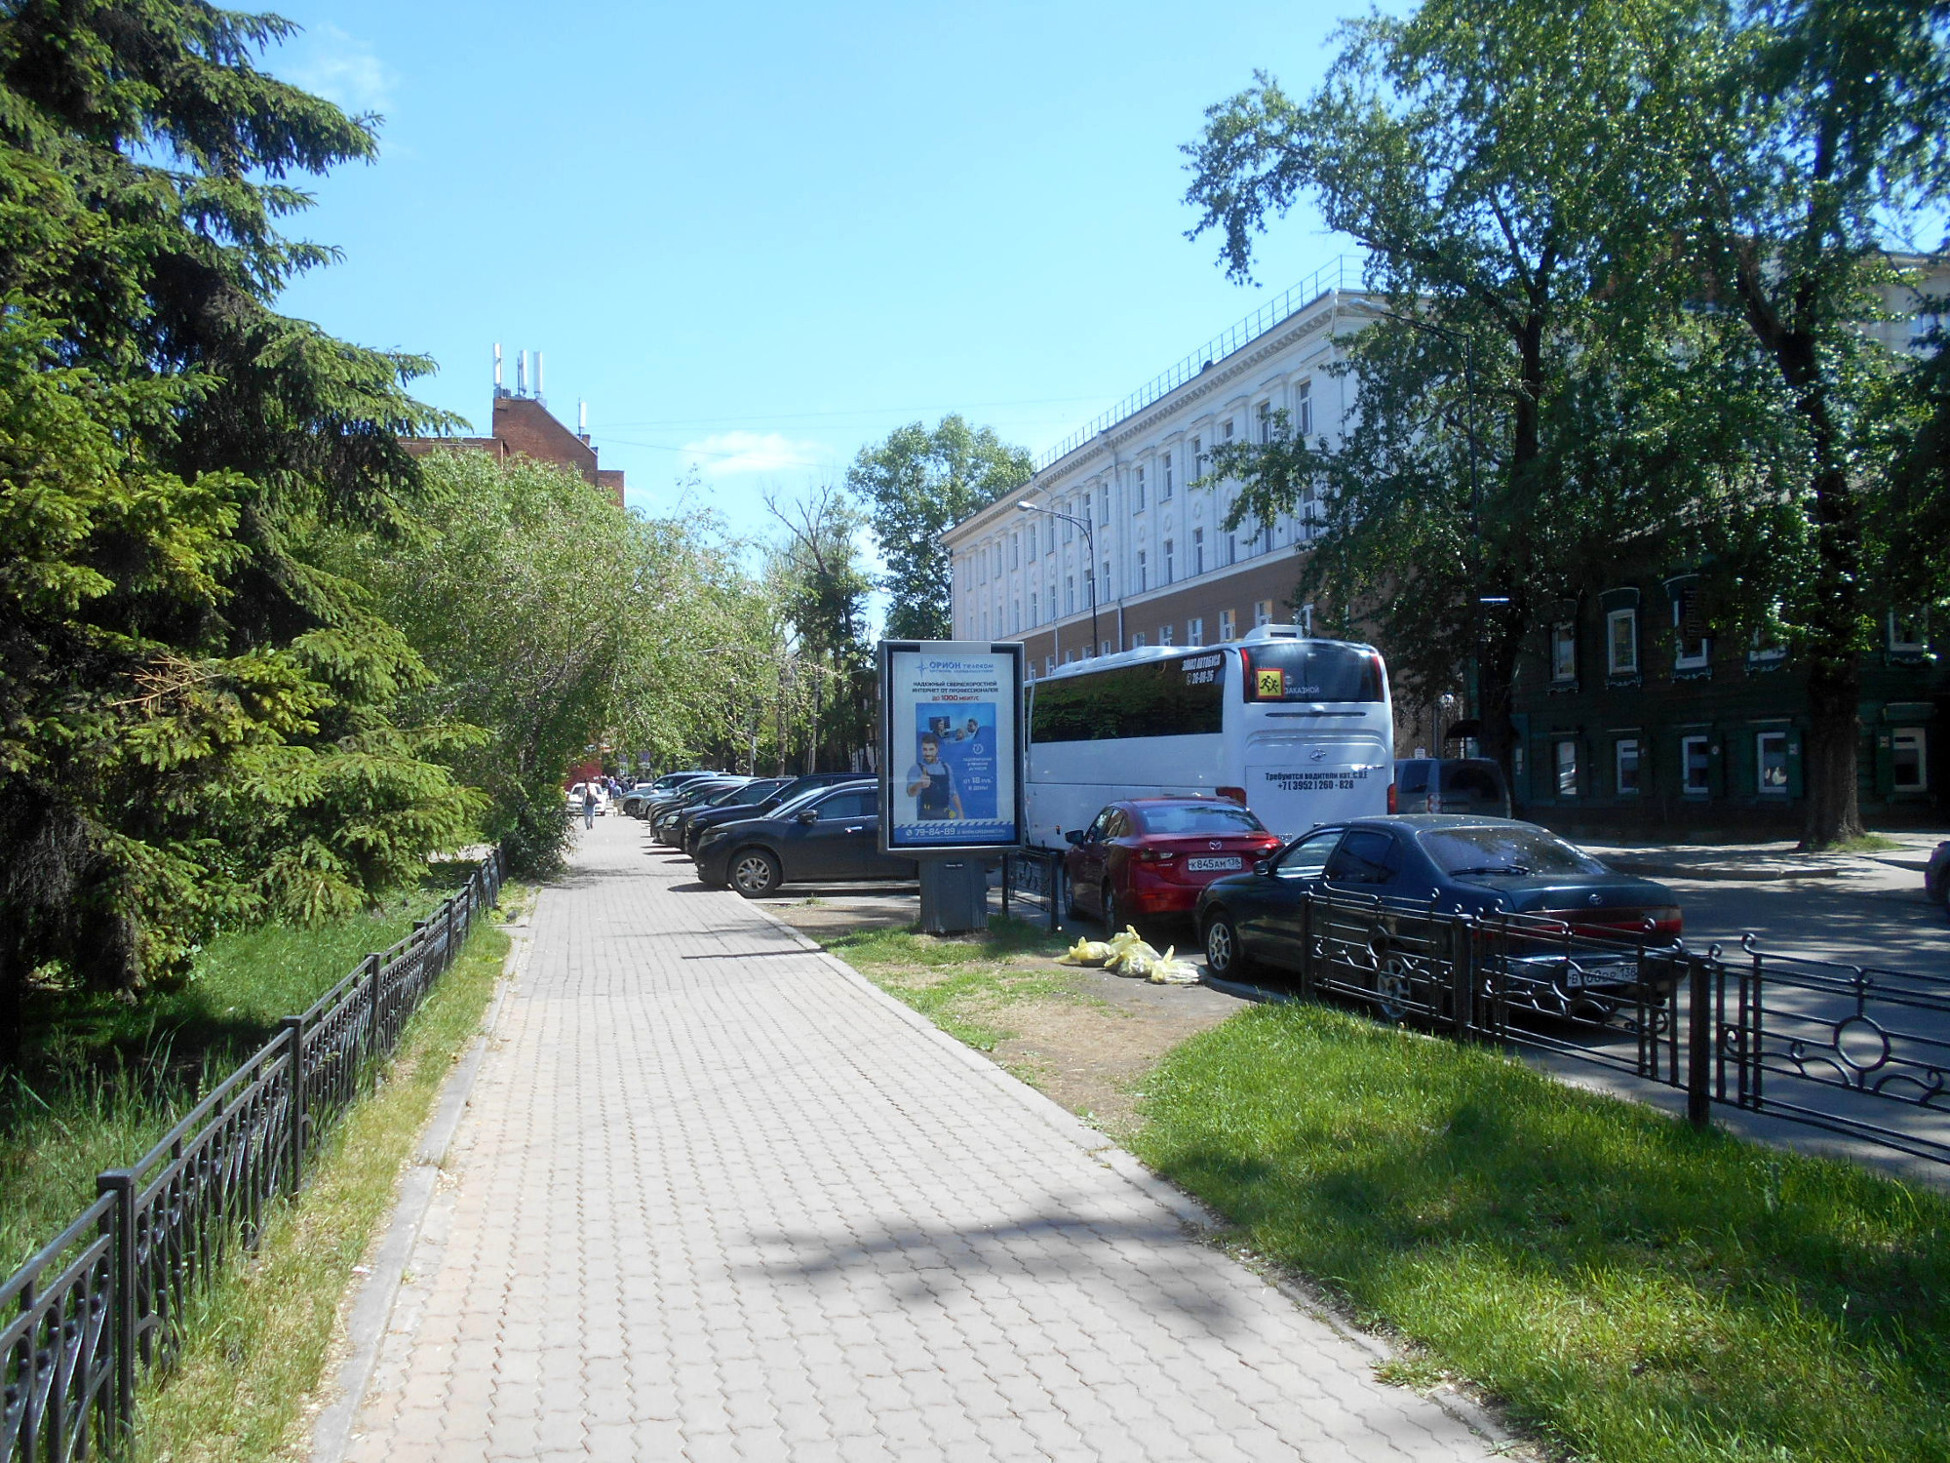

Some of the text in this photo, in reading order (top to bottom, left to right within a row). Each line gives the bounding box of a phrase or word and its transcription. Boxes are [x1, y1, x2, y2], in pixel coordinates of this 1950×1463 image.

[929, 661, 961, 669] ОРИОН
[1285, 685, 1320, 694] ЗАКАЗНОЙ
[1265, 772, 1303, 781] Требуются
[1305, 772, 1338, 780] водители
[915, 828, 955, 836] 79-84-89
